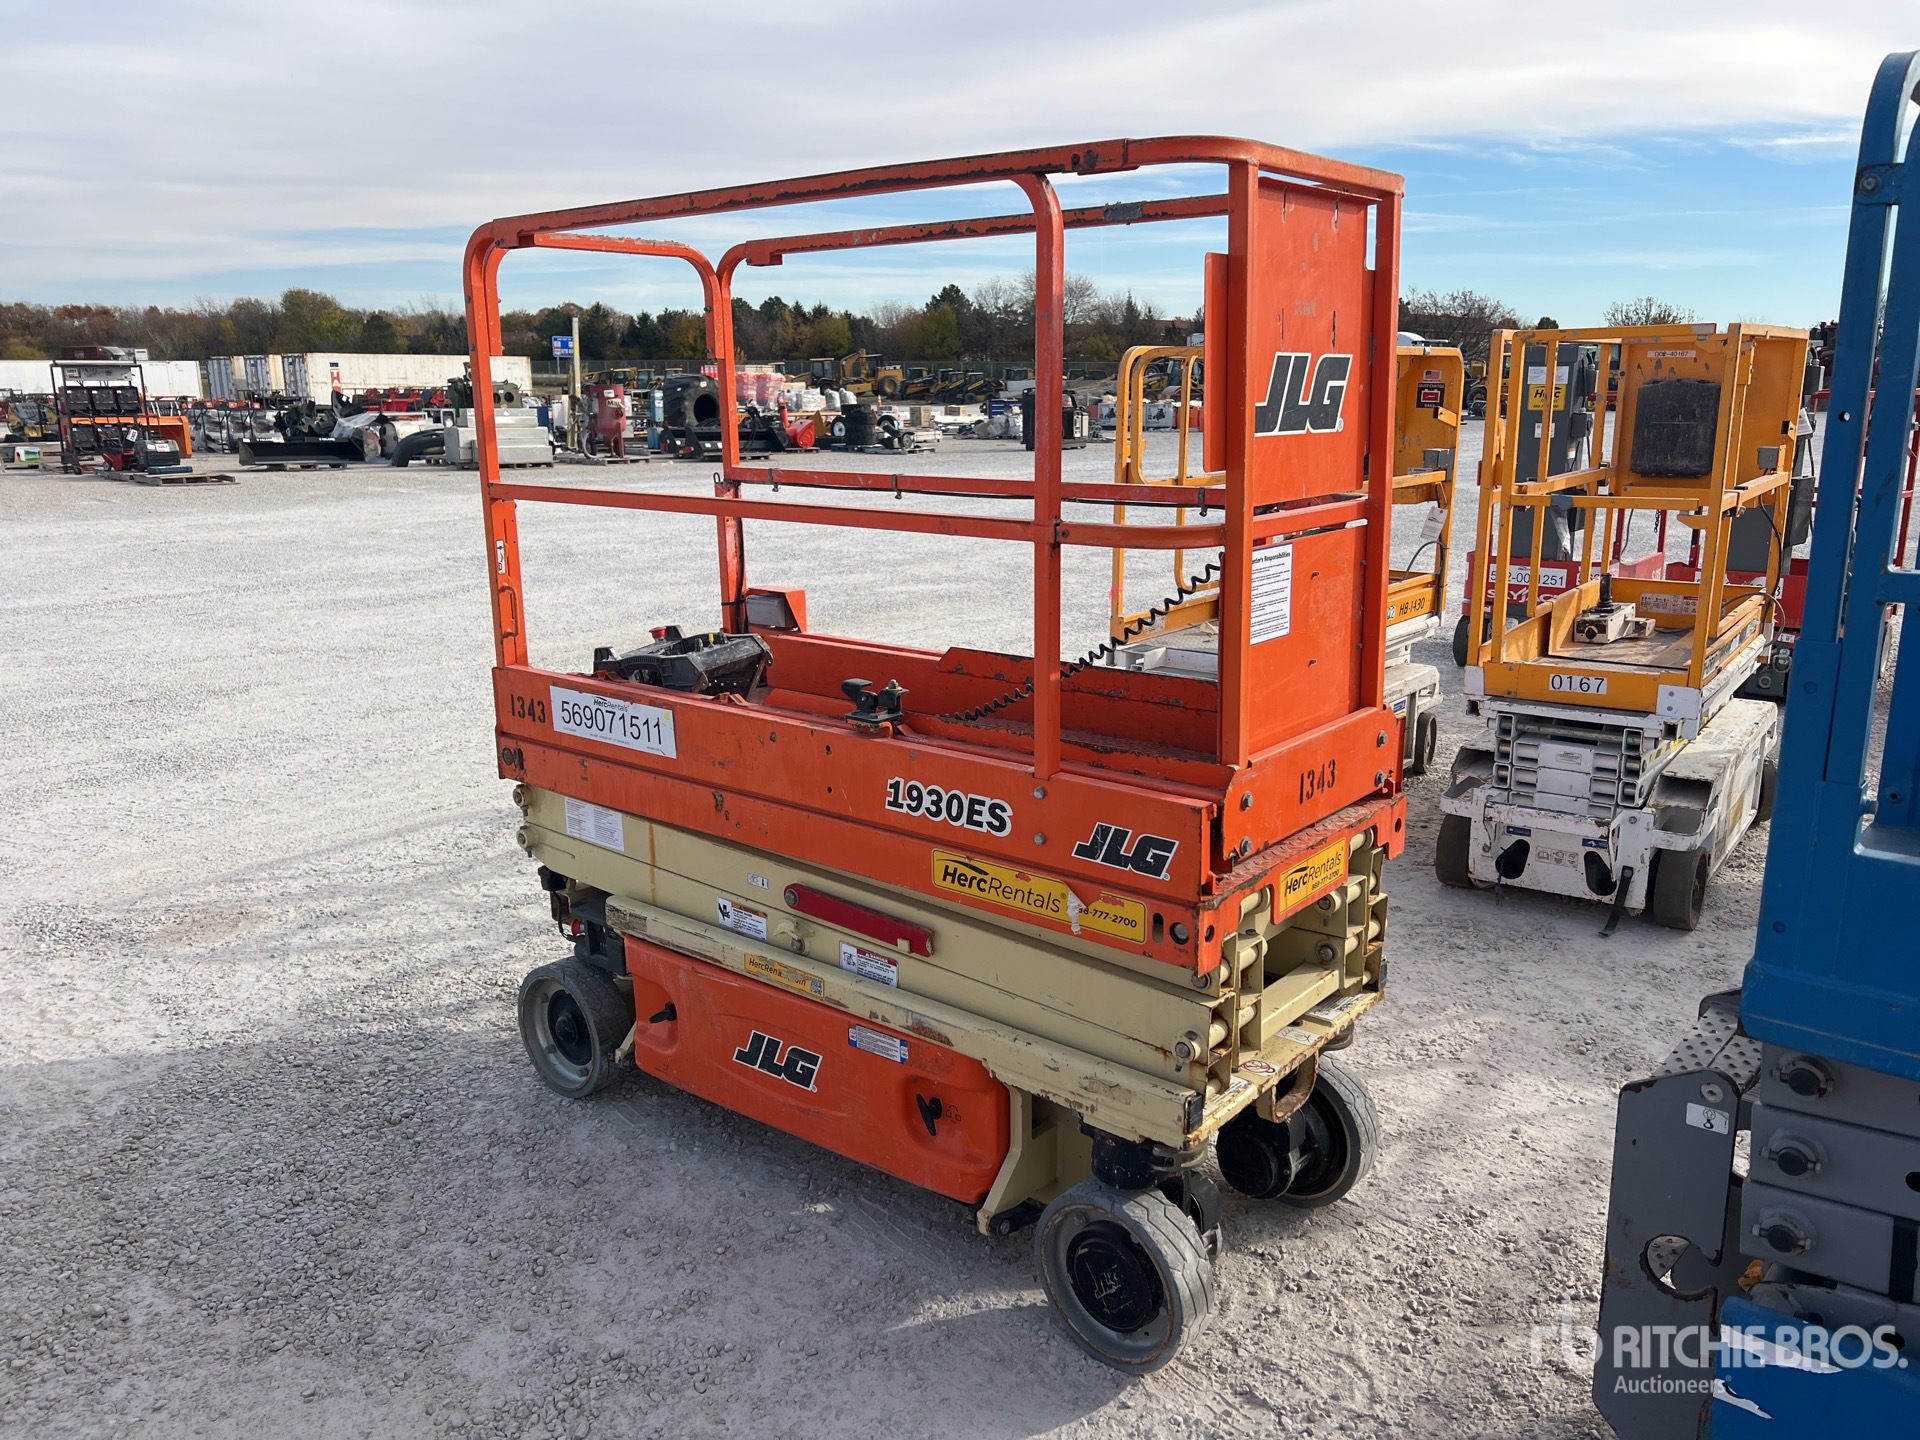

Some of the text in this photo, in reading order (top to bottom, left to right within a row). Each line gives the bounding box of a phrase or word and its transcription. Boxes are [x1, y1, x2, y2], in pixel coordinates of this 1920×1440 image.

[1255, 352, 1352, 434] JLG
[1533, 389, 1561, 399] Hc
[1490, 571, 1564, 587] 52-001251
[593, 698, 628, 712] HercRentals
[1551, 674, 1605, 693] 0167
[510, 693, 546, 724] 1343
[561, 700, 662, 745] 569071511
[1300, 759, 1336, 804] 1343
[886, 778, 1012, 836] 1930ES
[1073, 822, 1179, 880] JLG
[942, 864, 1061, 914] HercRentals
[1284, 851, 1342, 897] HercRentals
[733, 1029, 823, 1091] JLG
